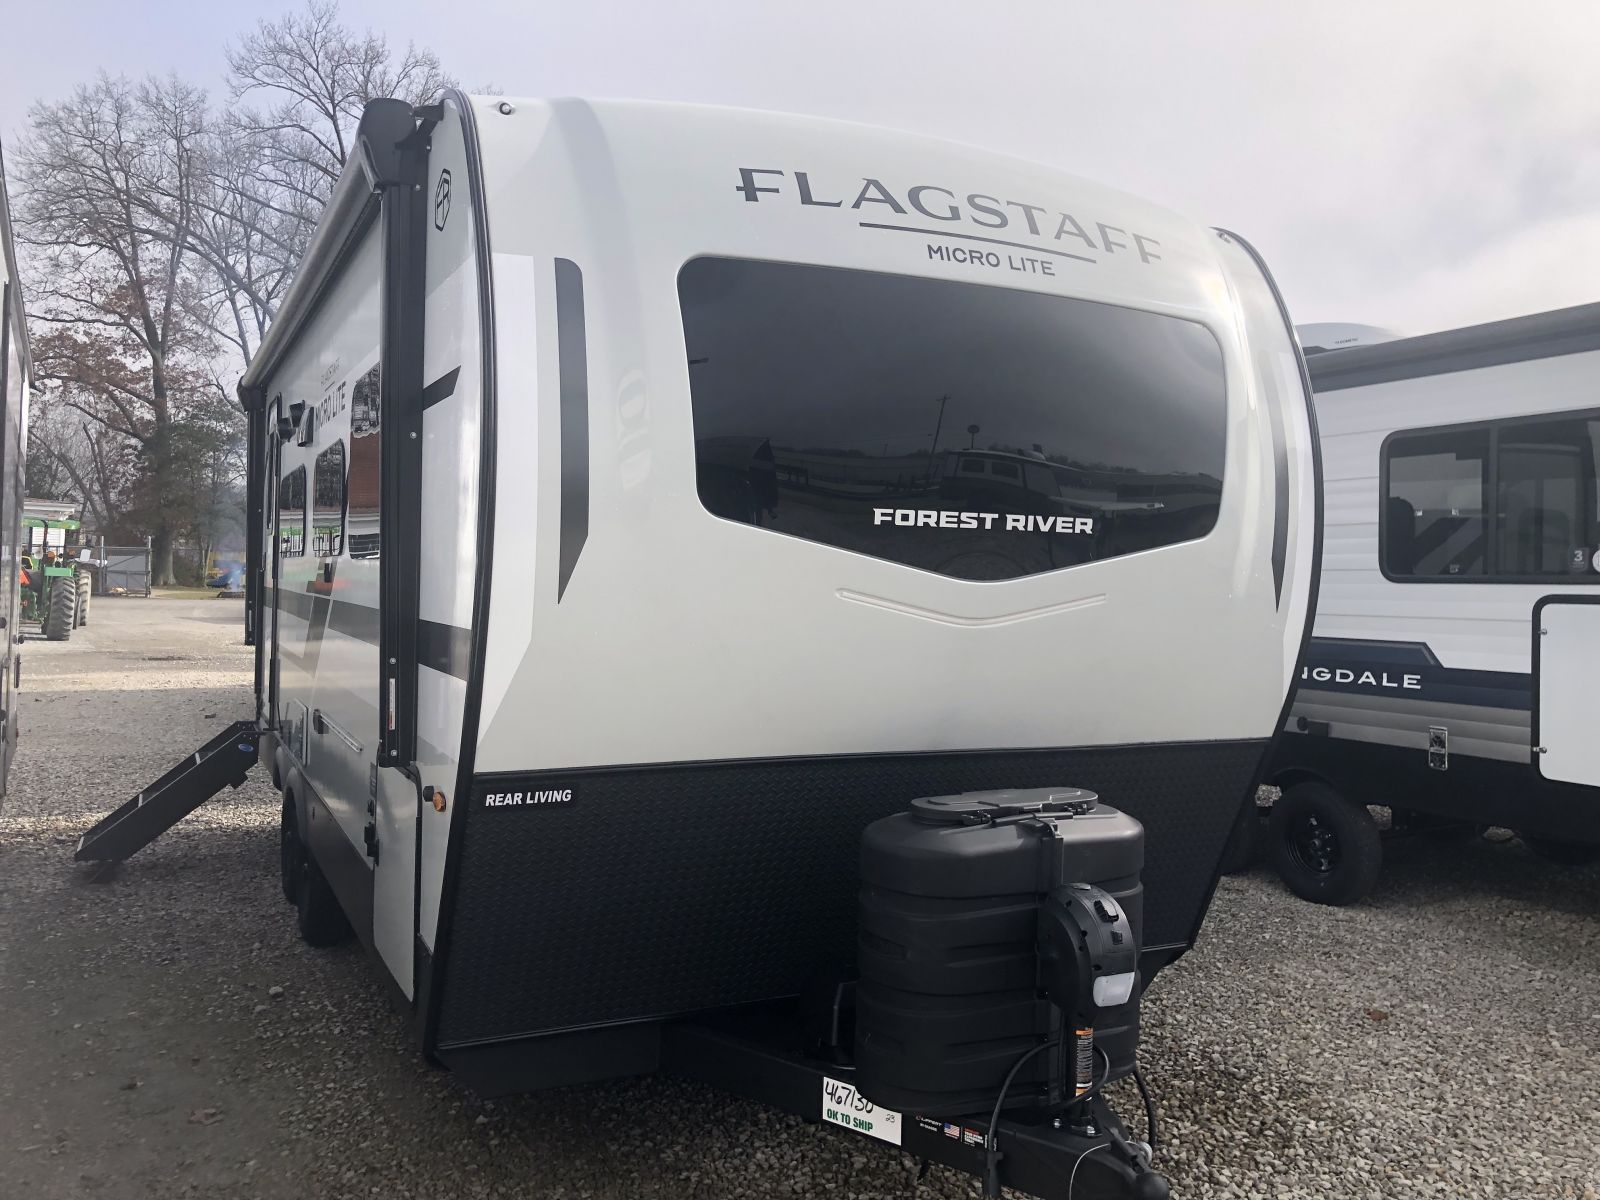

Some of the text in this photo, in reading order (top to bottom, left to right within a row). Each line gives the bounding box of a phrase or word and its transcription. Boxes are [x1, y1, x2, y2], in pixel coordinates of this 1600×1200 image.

[735, 167, 1163, 265] FLAGSTAFF
[927, 243, 1056, 277] MICRO LITE
[873, 508, 1094, 535] FOREST RIVER
[1574, 550, 1583, 561] 3
[485, 789, 572, 807] REAR LIVING
[826, 1108, 874, 1132] OK TO SHIP
